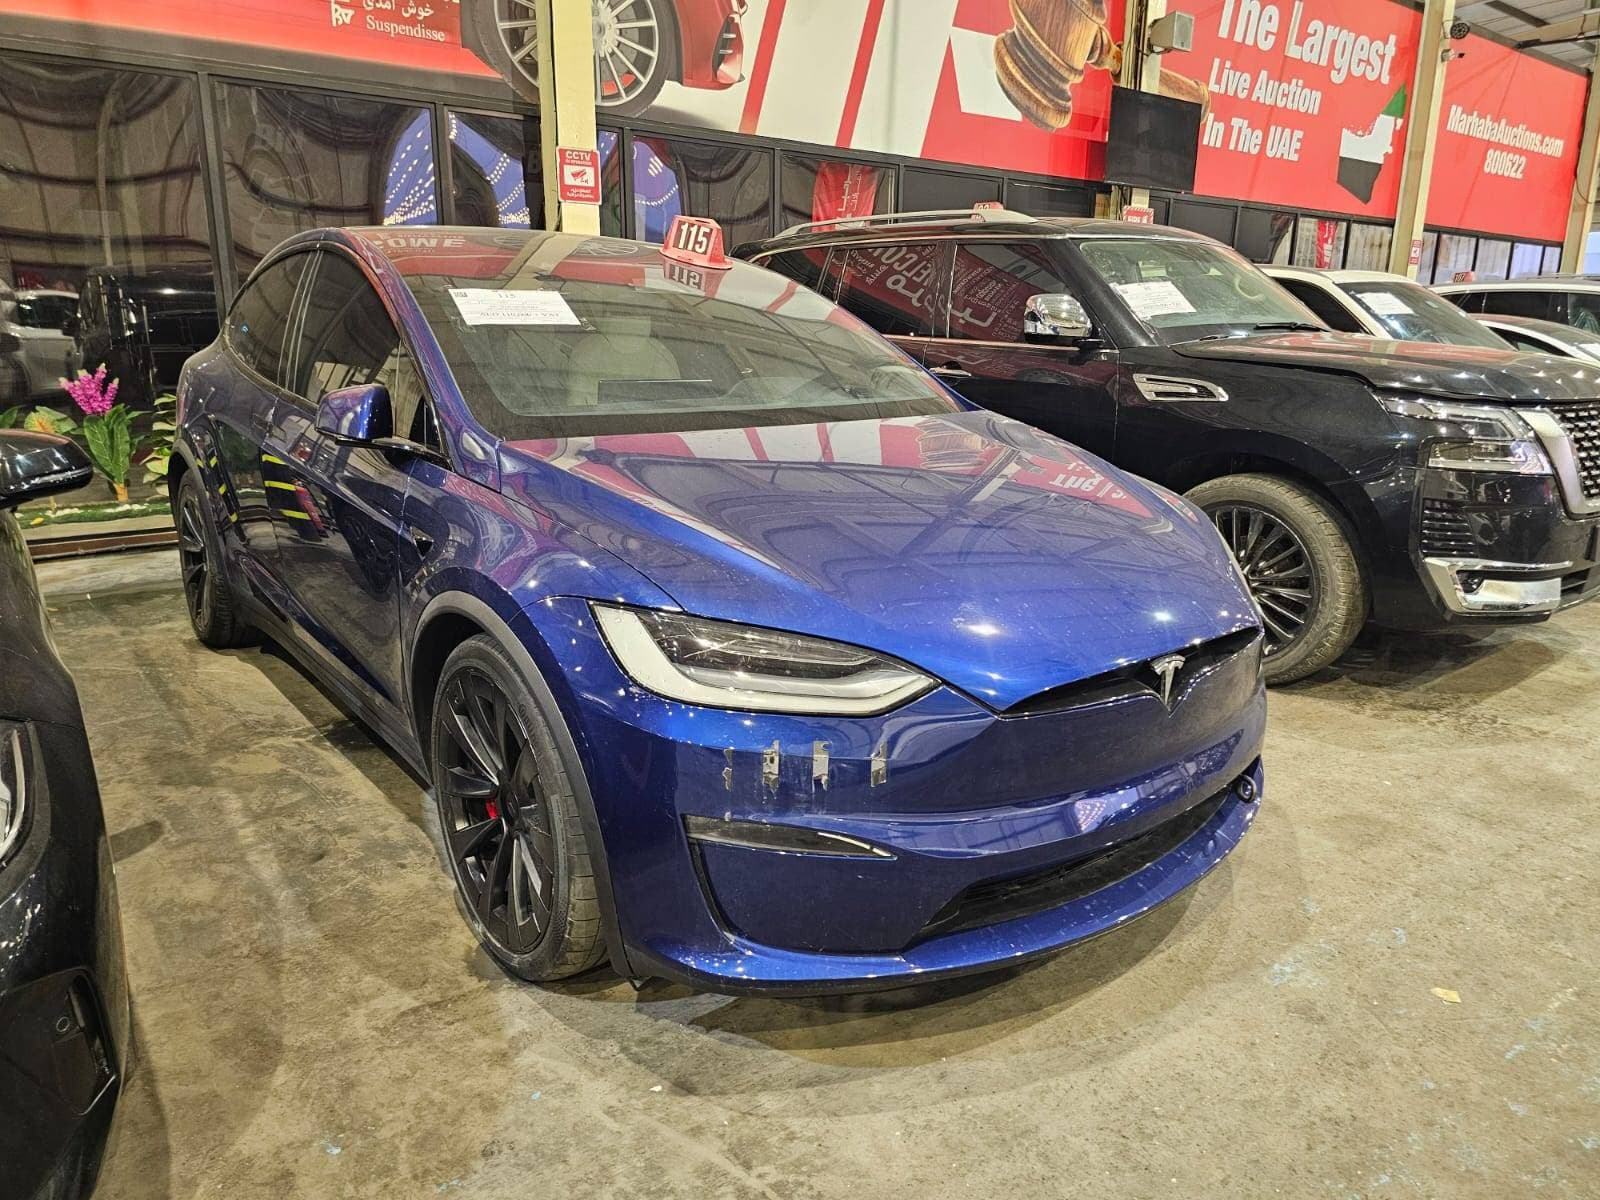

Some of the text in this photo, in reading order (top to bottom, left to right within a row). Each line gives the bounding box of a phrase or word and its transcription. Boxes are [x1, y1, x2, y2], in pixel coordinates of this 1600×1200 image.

[366, 15, 445, 42] Suspendisse
[1218, 0, 1397, 85] The Largest
[1208, 58, 1322, 116] Live Auction
[1202, 112, 1305, 163] In The UAE
[1446, 105, 1564, 158] MarhabaAuctions.com
[565, 150, 592, 161] CCTV
[1483, 147, 1527, 180] 800622
[678, 222, 710, 254] 115
